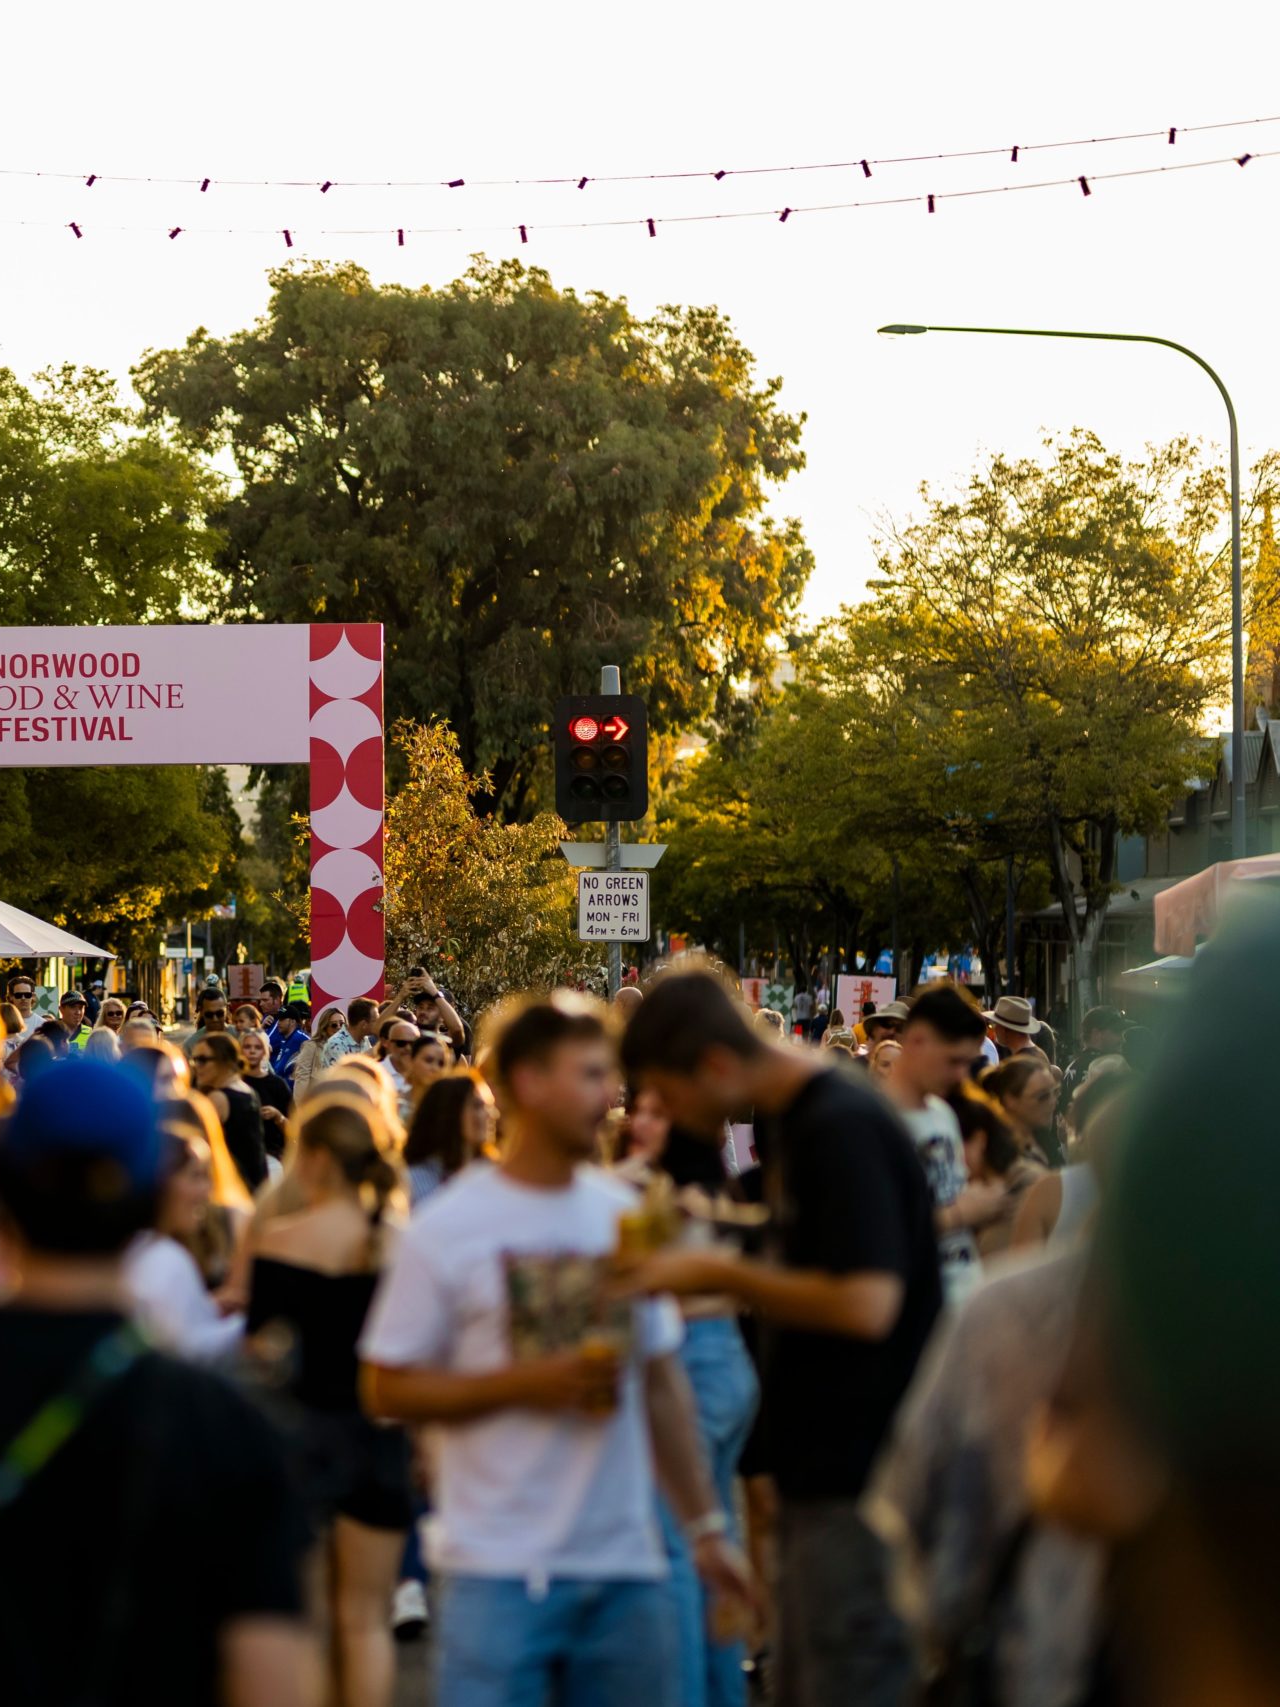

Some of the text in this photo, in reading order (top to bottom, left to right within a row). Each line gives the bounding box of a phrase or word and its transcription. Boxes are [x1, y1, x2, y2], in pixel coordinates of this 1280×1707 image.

[53, 684, 80, 710] &
[86, 684, 184, 710] WINE
[583, 877, 644, 890] NO GREEN
[588, 894, 639, 906] ARROWS
[587, 912, 610, 922] MON
[622, 912, 640, 922] FRI
[586, 925, 607, 935] 4PM
[621, 925, 640, 936] 6PM
